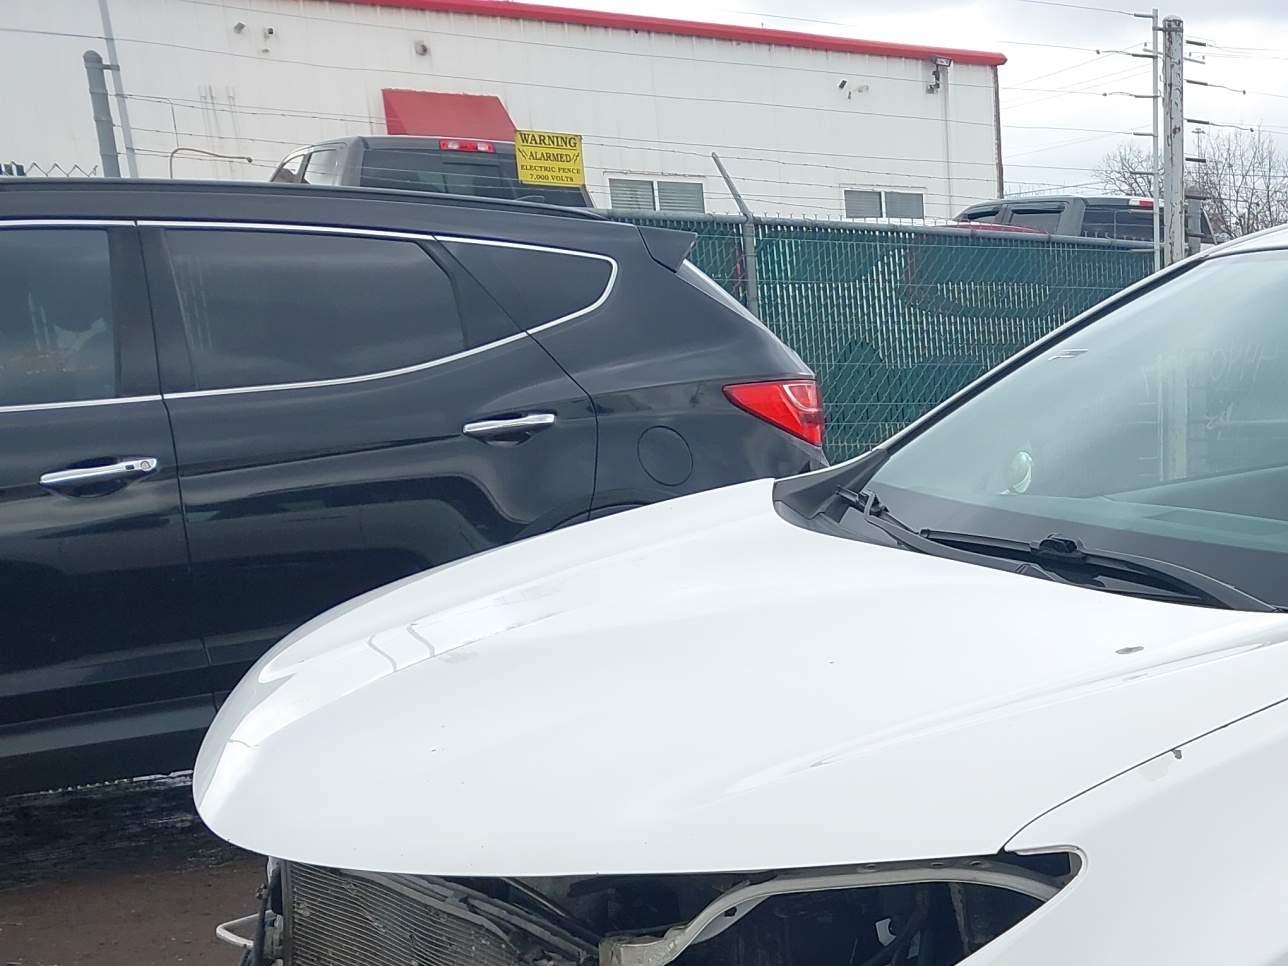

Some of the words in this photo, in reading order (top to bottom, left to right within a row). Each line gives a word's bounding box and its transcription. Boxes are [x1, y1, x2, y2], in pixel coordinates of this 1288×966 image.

[519, 133, 577, 148] WARNING
[528, 151, 572, 163] ALARMED
[520, 164, 557, 173] ELECTRIC
[557, 167, 581, 175] FENCE
